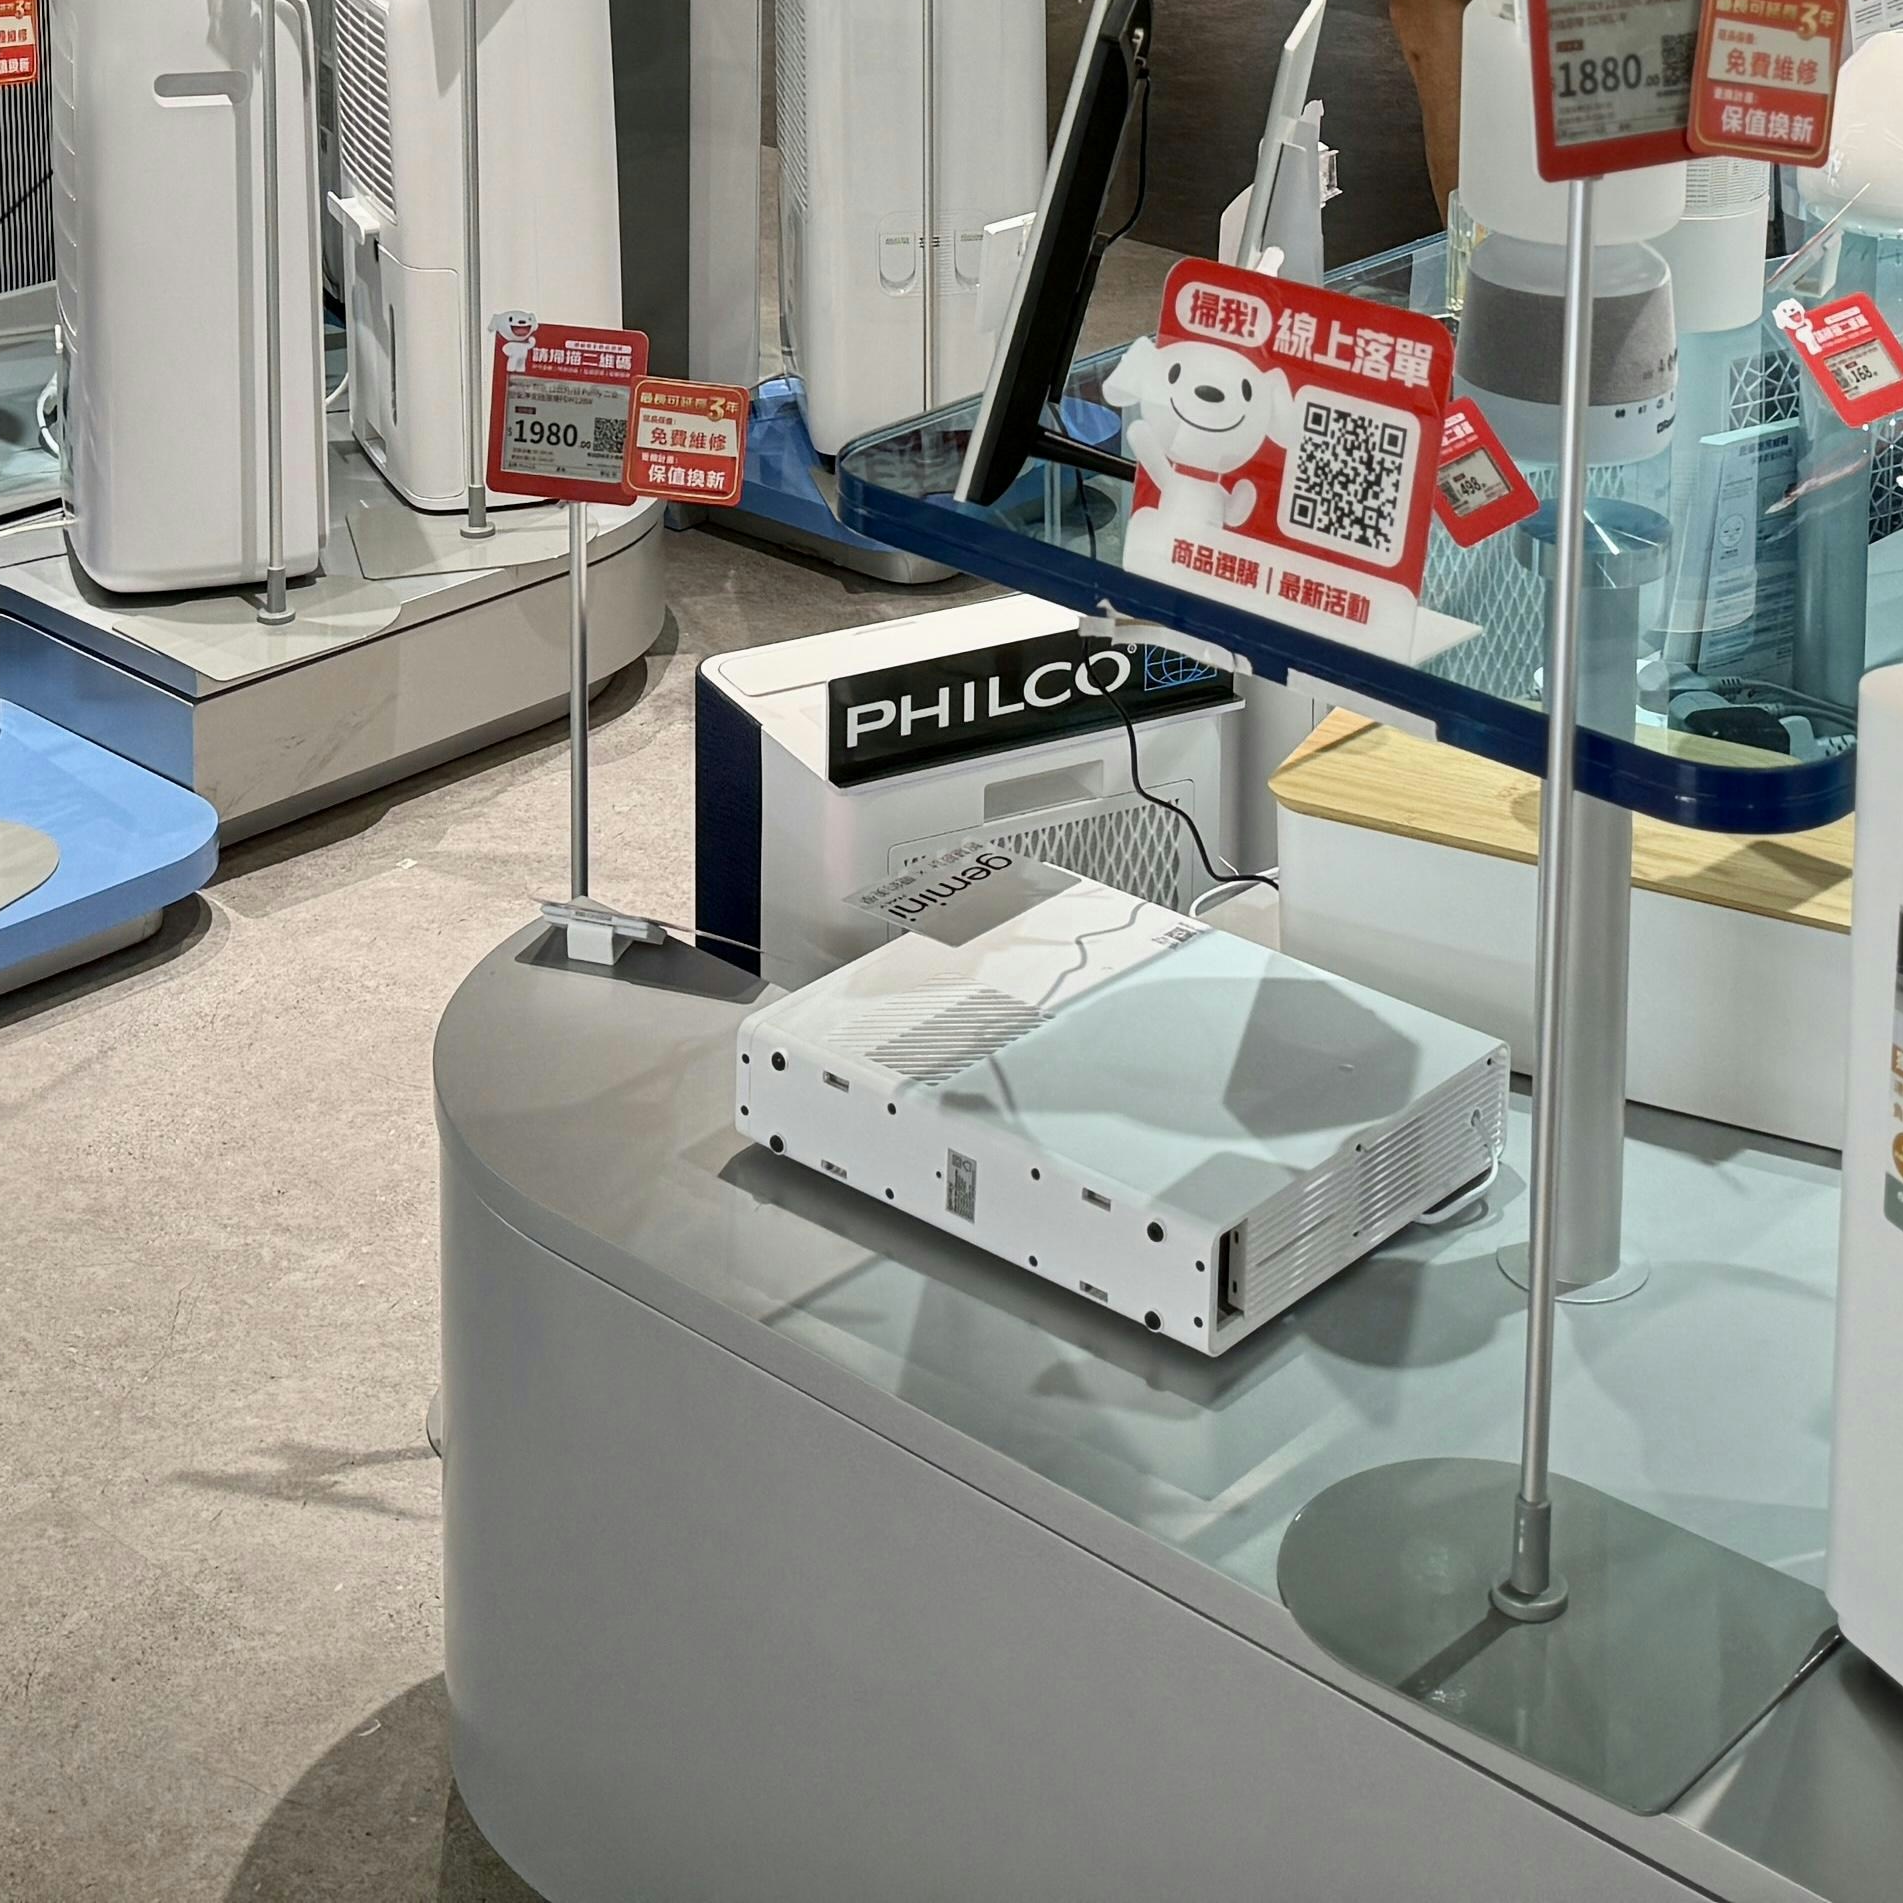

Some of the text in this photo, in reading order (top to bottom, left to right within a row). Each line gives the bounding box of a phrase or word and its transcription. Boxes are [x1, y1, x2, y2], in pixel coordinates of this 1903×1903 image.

[1725, 47, 1820, 86] 免費維修
[1720, 105, 1815, 144] 保值換新
[1189, 287, 1435, 389] 掃我! 線上落單
[531, 346, 633, 370] 請掃描二維碼
[650, 426, 727, 452] 免費維修
[647, 463, 727, 490] 保值換新
[1170, 537, 1372, 626] 商品選購 最新活動
[844, 647, 1134, 750] PHILCO
